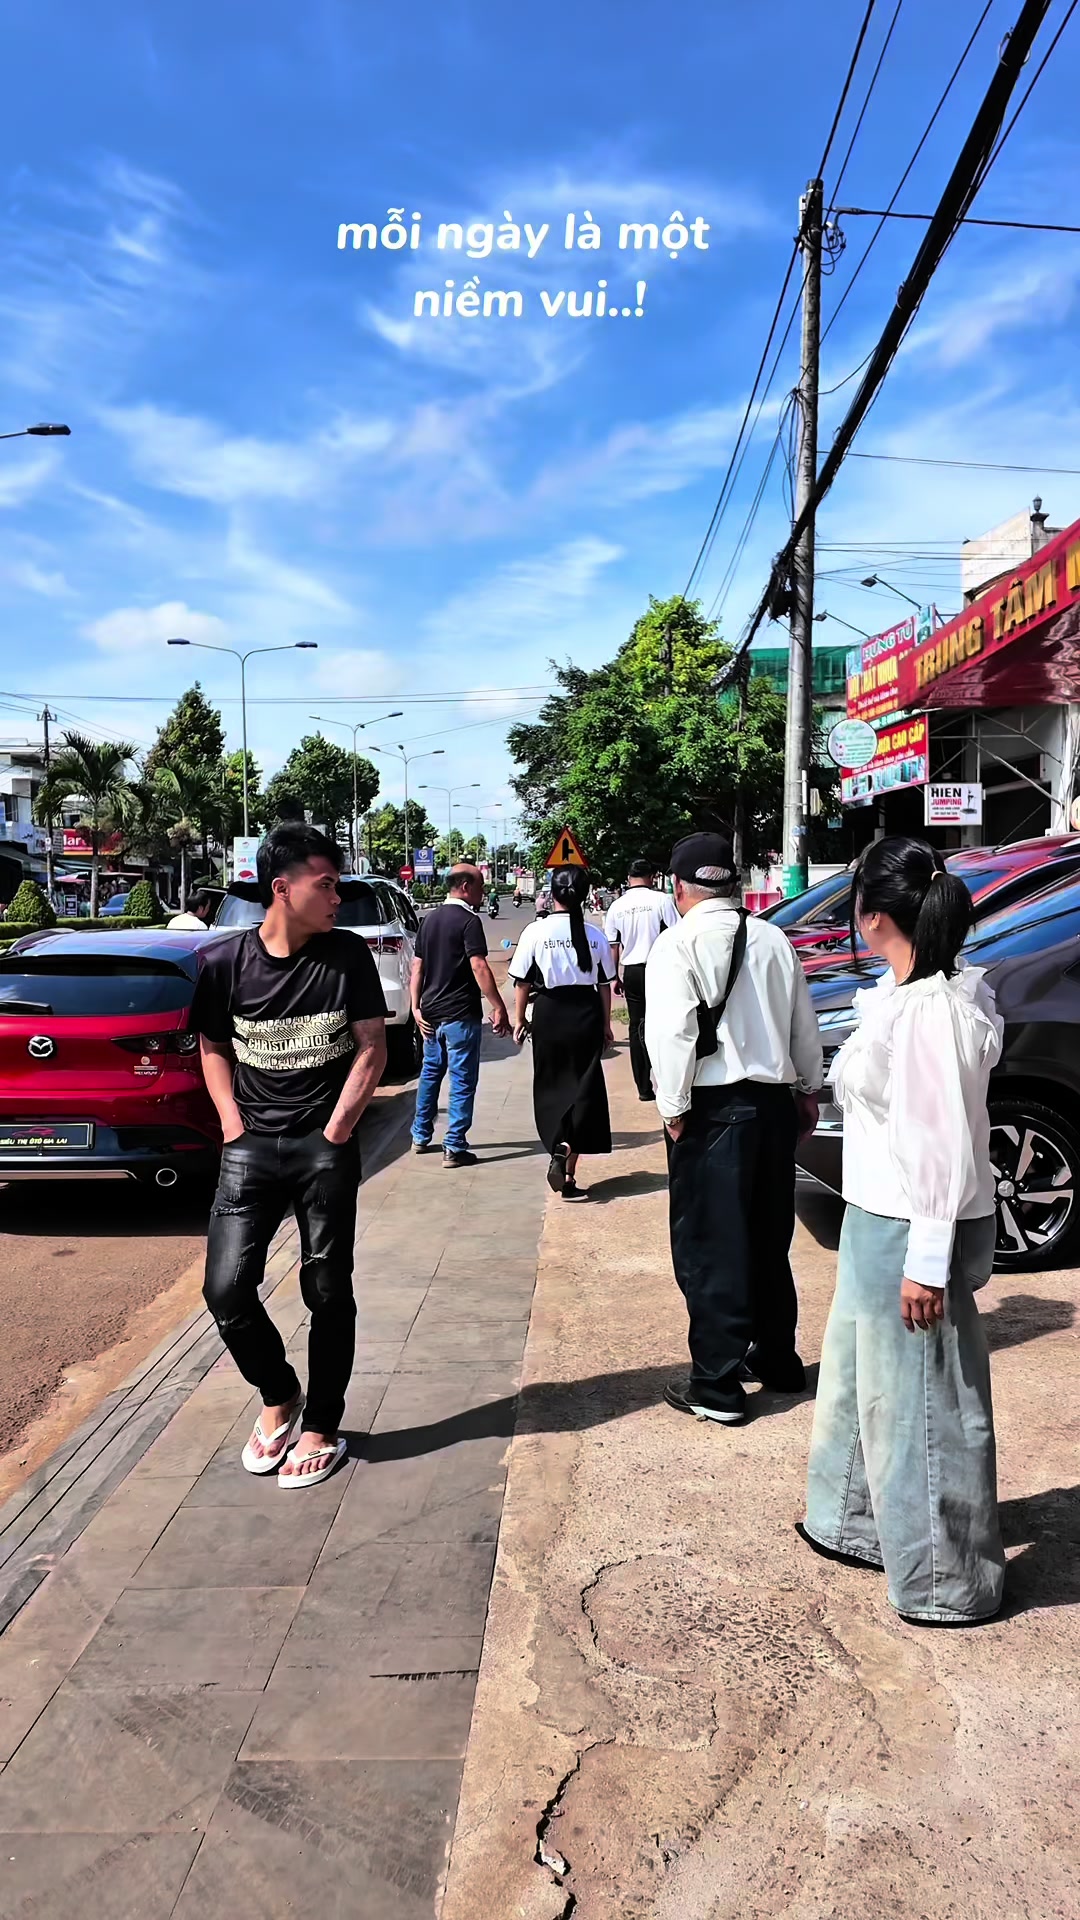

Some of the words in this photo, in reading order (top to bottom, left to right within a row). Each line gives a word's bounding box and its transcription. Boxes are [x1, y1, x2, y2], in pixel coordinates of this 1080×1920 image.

[914, 615, 984, 688] TRUNG
[990, 558, 1057, 640] TÂM
[891, 729, 907, 750] CAO
